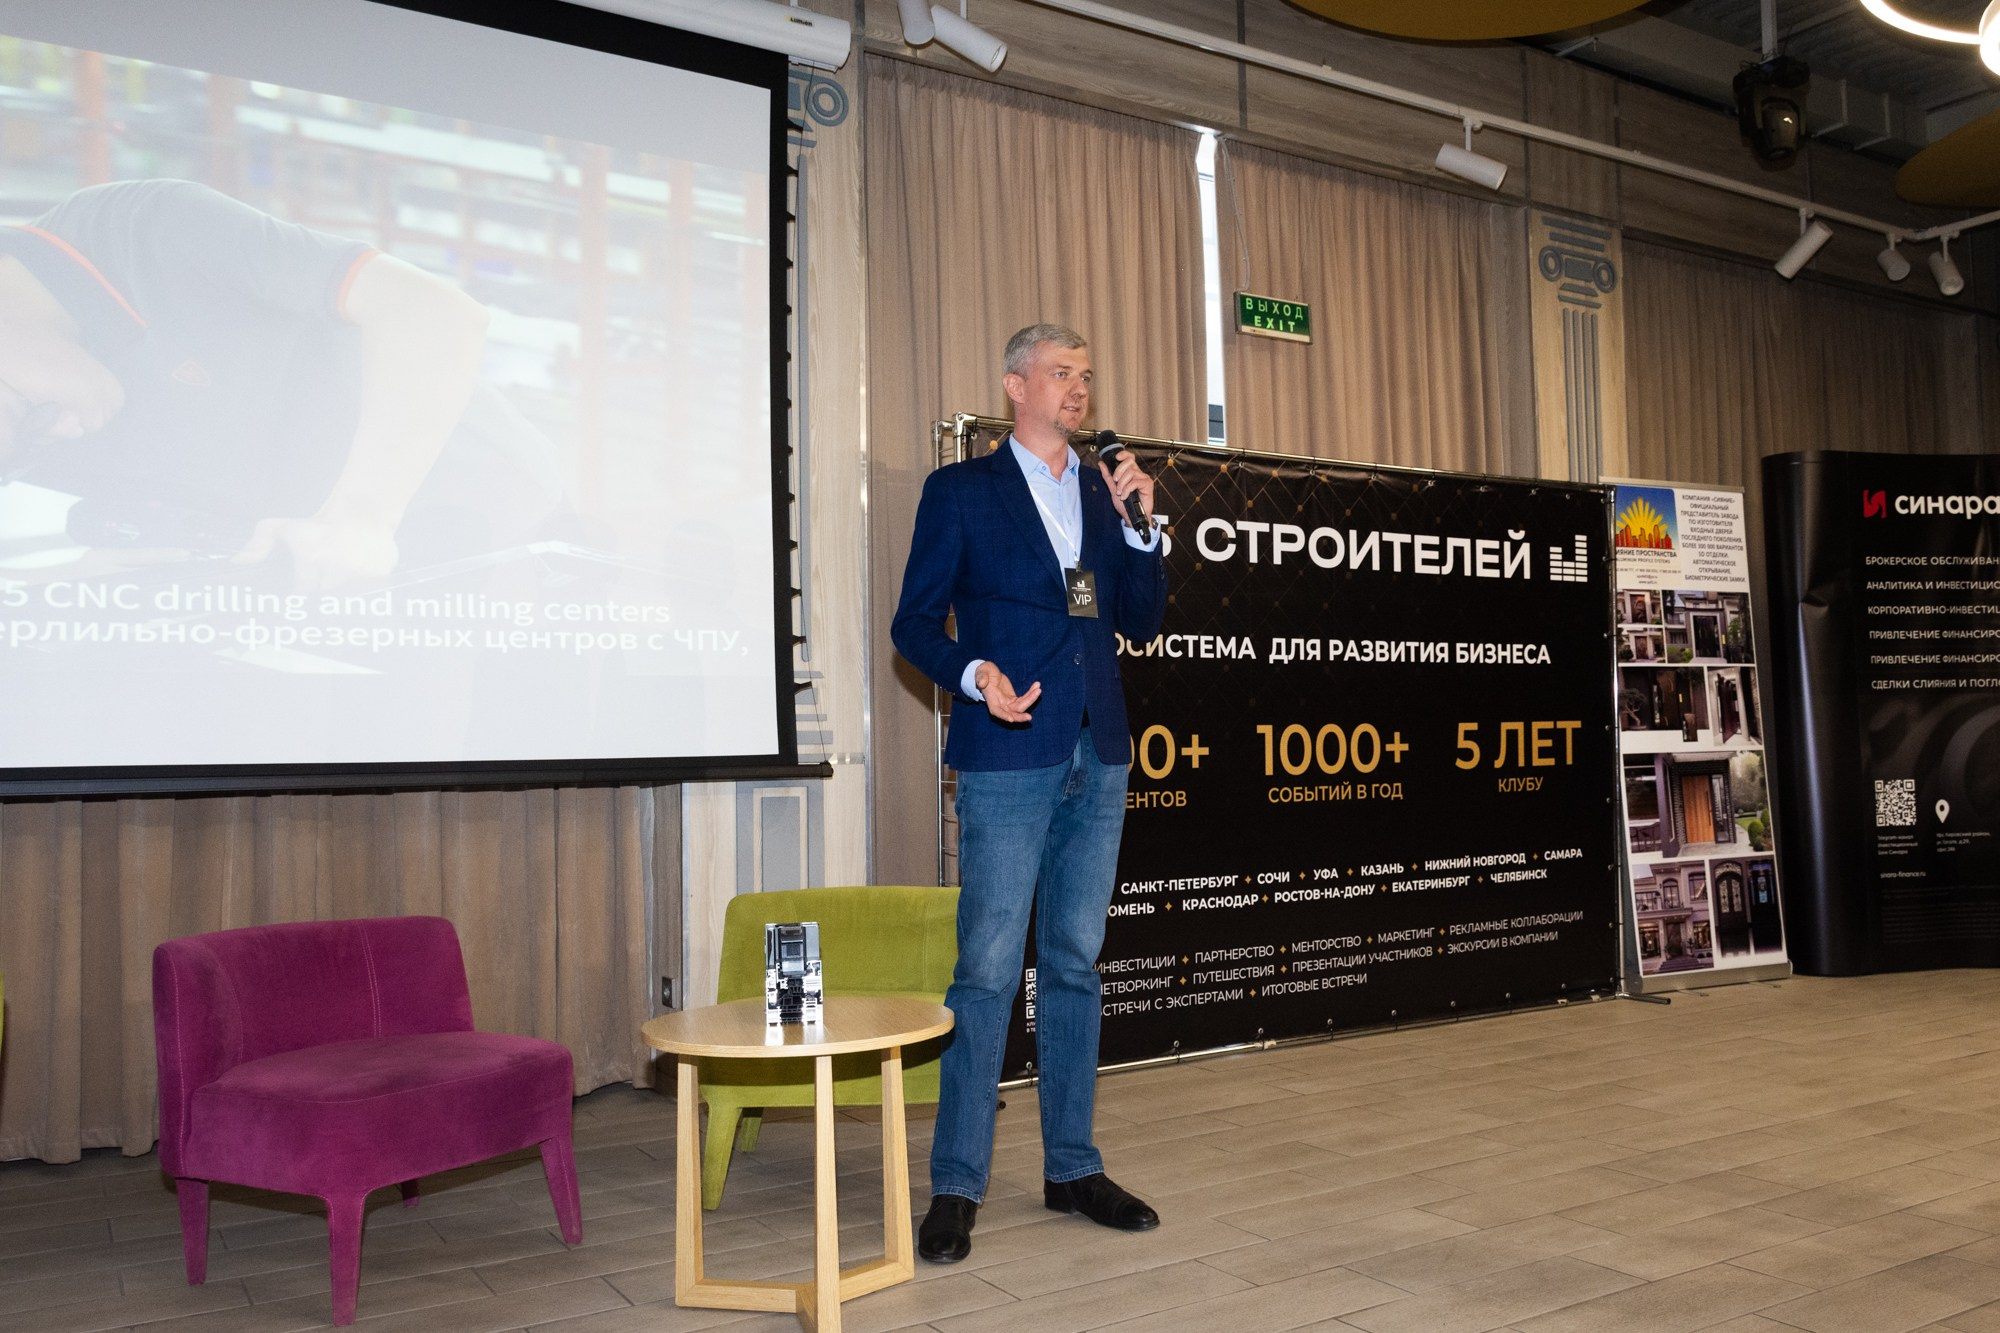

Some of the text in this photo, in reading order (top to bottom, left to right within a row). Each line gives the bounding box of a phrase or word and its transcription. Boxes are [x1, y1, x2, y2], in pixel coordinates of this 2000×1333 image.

[1245, 297, 1304, 321] ВЫХОД
[1253, 315, 1296, 333] EXIT
[1895, 494, 2000, 519] синара
[1196, 516, 1531, 580] СТРОИТЕЛЕЙ
[1636, 549, 1678, 558] ПРОСТРАНСТВА
[1865, 556, 1928, 566] БРОКЕРСКОЕ
[1866, 580, 1923, 590] АНАЛИТИКА
[1925, 580, 1934, 590] И
[44, 581, 141, 610] CNC
[154, 583, 308, 622] drilling
[319, 590, 392, 617] and
[407, 592, 535, 627] milling
[544, 600, 671, 624] centers
[1073, 593, 1092, 606] VIP
[0, 617, 749, 657] рлильно-фрезерных центров с ЧПУ,
[1869, 629, 1940, 640] ПРИВЛЕЧЕНИЕ
[1269, 637, 1322, 665] ДЛЯ
[1329, 639, 1449, 664] РАЗВИТИЯ
[1456, 641, 1551, 665] БИЗНЕСА
[1870, 654, 1941, 665] ПРИВЛЕЧЕНИЕ
[1871, 677, 2000, 690] СДЕЛКИ СЛИЯНИЯ И ПОГЛ
[1128, 724, 1210, 780] 0+
[1256, 722, 1410, 776] 1000+
[1455, 720, 1583, 770] 5 ЛЕТ
[1268, 781, 1404, 804] СОБЫТИЙ В ГОД
[1498, 776, 1544, 793] КЛУБУ
[1120, 848, 1583, 895] САНКТ-ПЕТЕРБУРГ СОЧИ УФА КАЗАНЬ НИЖНИЙ НОВГОРОД САМАРА
[1182, 894, 1259, 911] КРАСНОДАР
[1274, 884, 1376, 903] РОСТОВ-НА-ДОНУ
[1392, 875, 1471, 893] ЕКАТЕРИНБУРГ
[1490, 868, 1548, 884] ЧЕЛЯБИНСК
[1194, 944, 1275, 964] ПАРТНЕРСТВО
[1292, 935, 1362, 953] МЕНТОРСТВО
[1377, 927, 1435, 944] МАРКЕТИНГ
[1450, 919, 1509, 935] РЕКЛАМНЫЕ
[1511, 911, 1584, 929] КОЛЛАБОРАЦИИ
[1193, 964, 1275, 985] ПУТЕШЕСТВИЯ
[1292, 954, 1367, 973] ПРЕЗЕНТАЦИИ
[1368, 946, 1433, 965] УЧАСТНИКОВ
[1447, 938, 1500, 955] ЭКСКУРСИИ
[1501, 936, 1508, 948] В
[1509, 931, 1559, 947] КОМПАНИИ
[1101, 972, 1368, 1017] СТРЕЧИ С ЭКСПЕРТАМИ ИТОГОВЫЕ ВСТРЕЧИ
